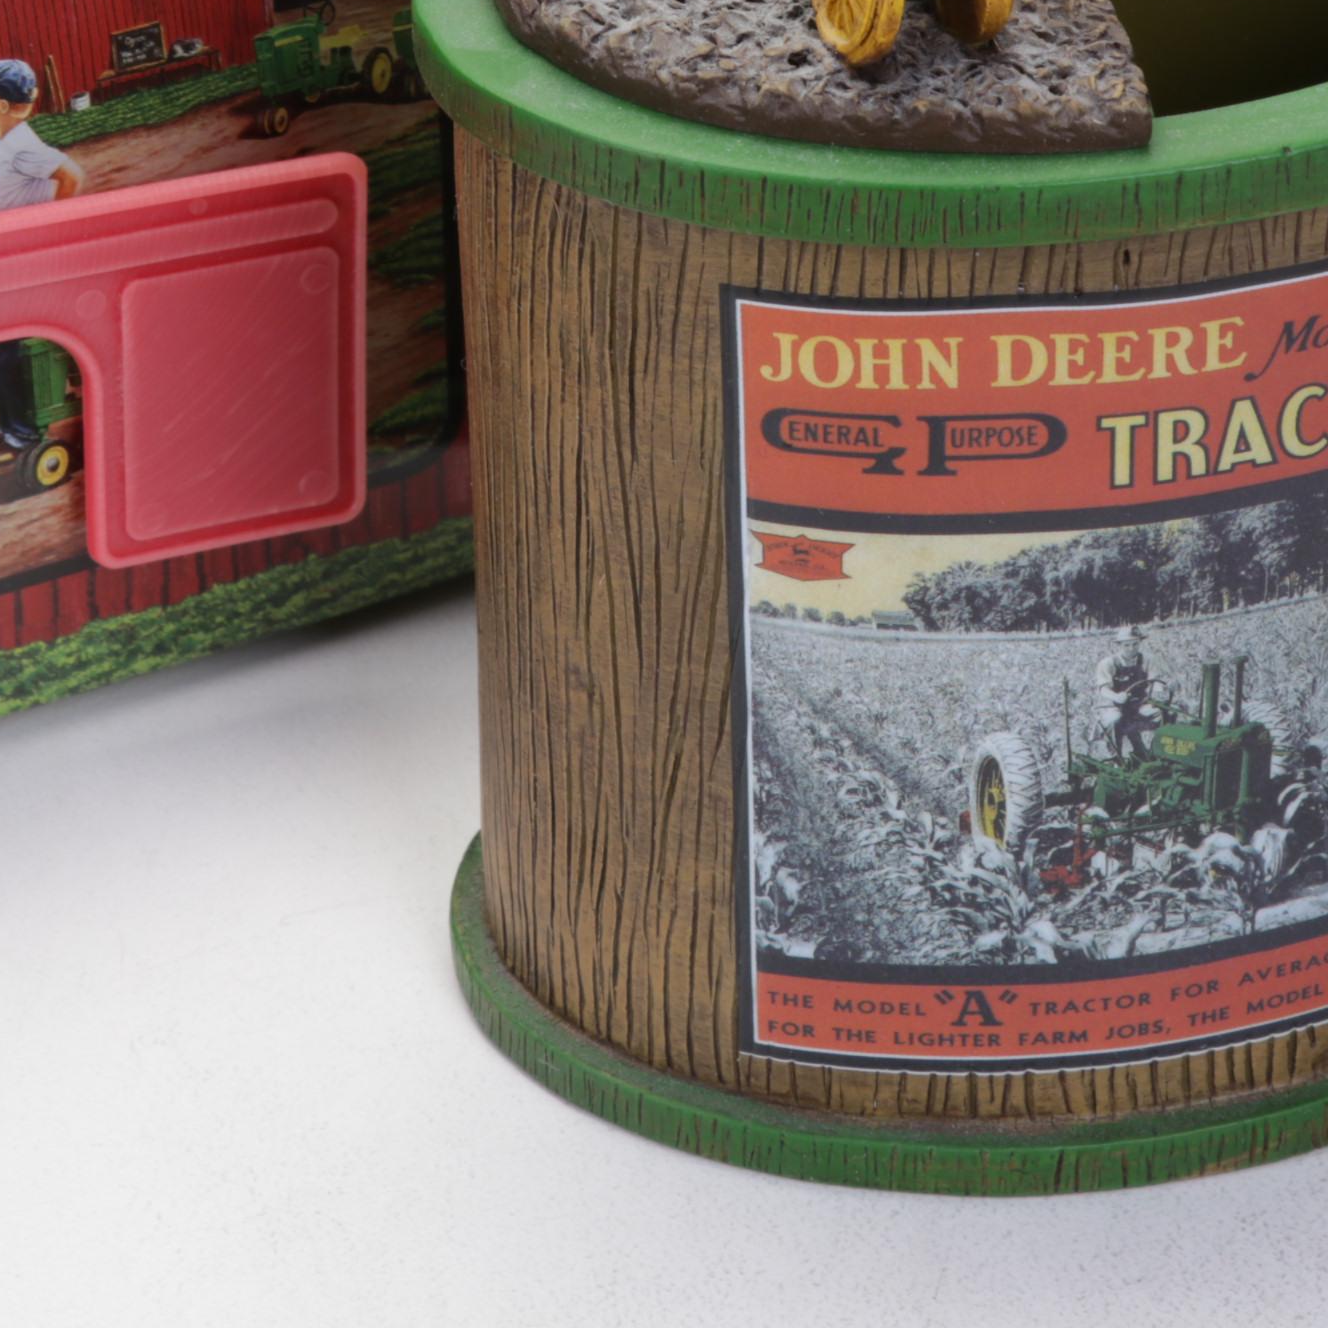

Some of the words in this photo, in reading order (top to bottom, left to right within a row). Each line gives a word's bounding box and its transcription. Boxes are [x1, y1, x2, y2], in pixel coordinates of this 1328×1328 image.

[759, 331, 964, 391] JOHN
[989, 315, 1249, 388] DEERE
[767, 989, 816, 1011] THE
[832, 997, 928, 1018] MODEL
[1028, 991, 1152, 1017] TRACTOR
[1170, 979, 1221, 1002] FOR
[767, 1019, 816, 1039] FOR
[832, 1026, 877, 1044] THE
[893, 1030, 1003, 1048] LIGHTER
[1018, 1028, 1090, 1047] FARM
[1105, 1018, 1172, 1042] JOBS,
[1186, 1006, 1231, 1028] THE
[1246, 982, 1325, 1015] MODEL
